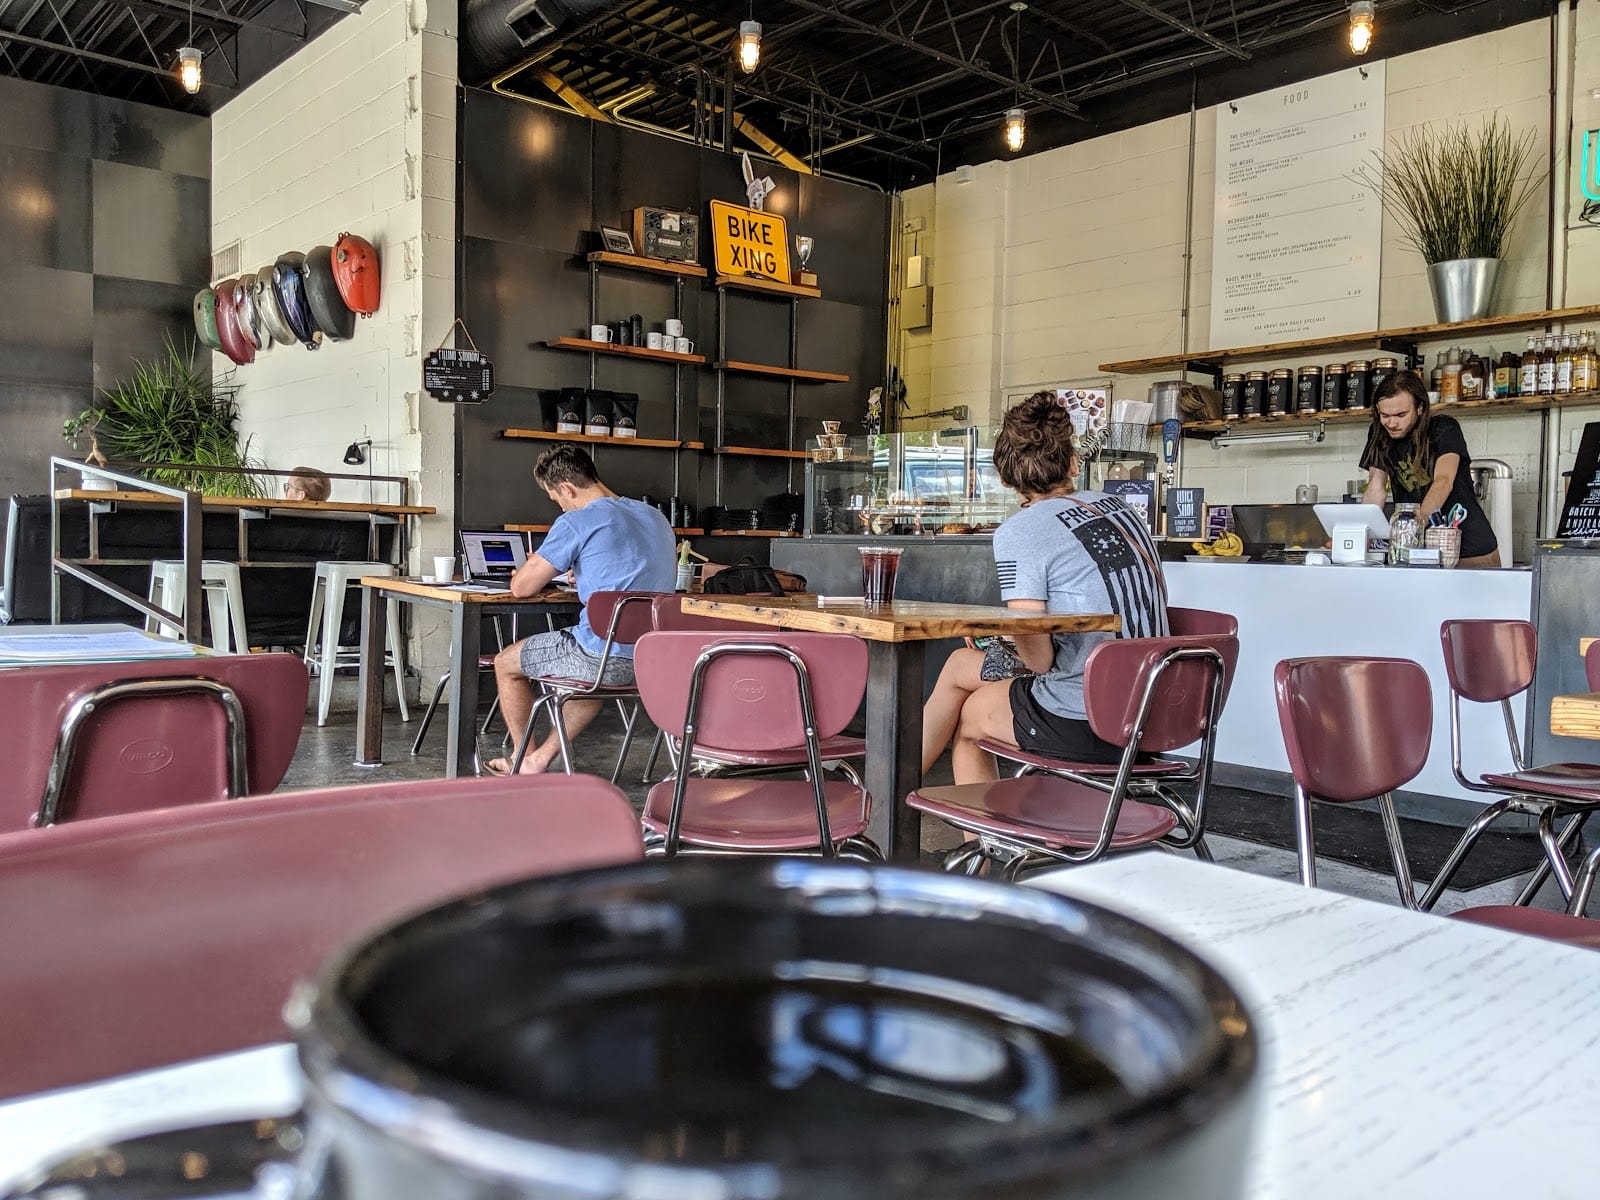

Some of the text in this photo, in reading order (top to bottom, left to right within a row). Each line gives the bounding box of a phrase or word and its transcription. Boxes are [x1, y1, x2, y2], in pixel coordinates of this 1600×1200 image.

[1283, 89, 1309, 105] FOOD
[727, 215, 773, 246] BIKE
[730, 244, 776, 274] XING
[1056, 496, 1127, 529] FREDOM
